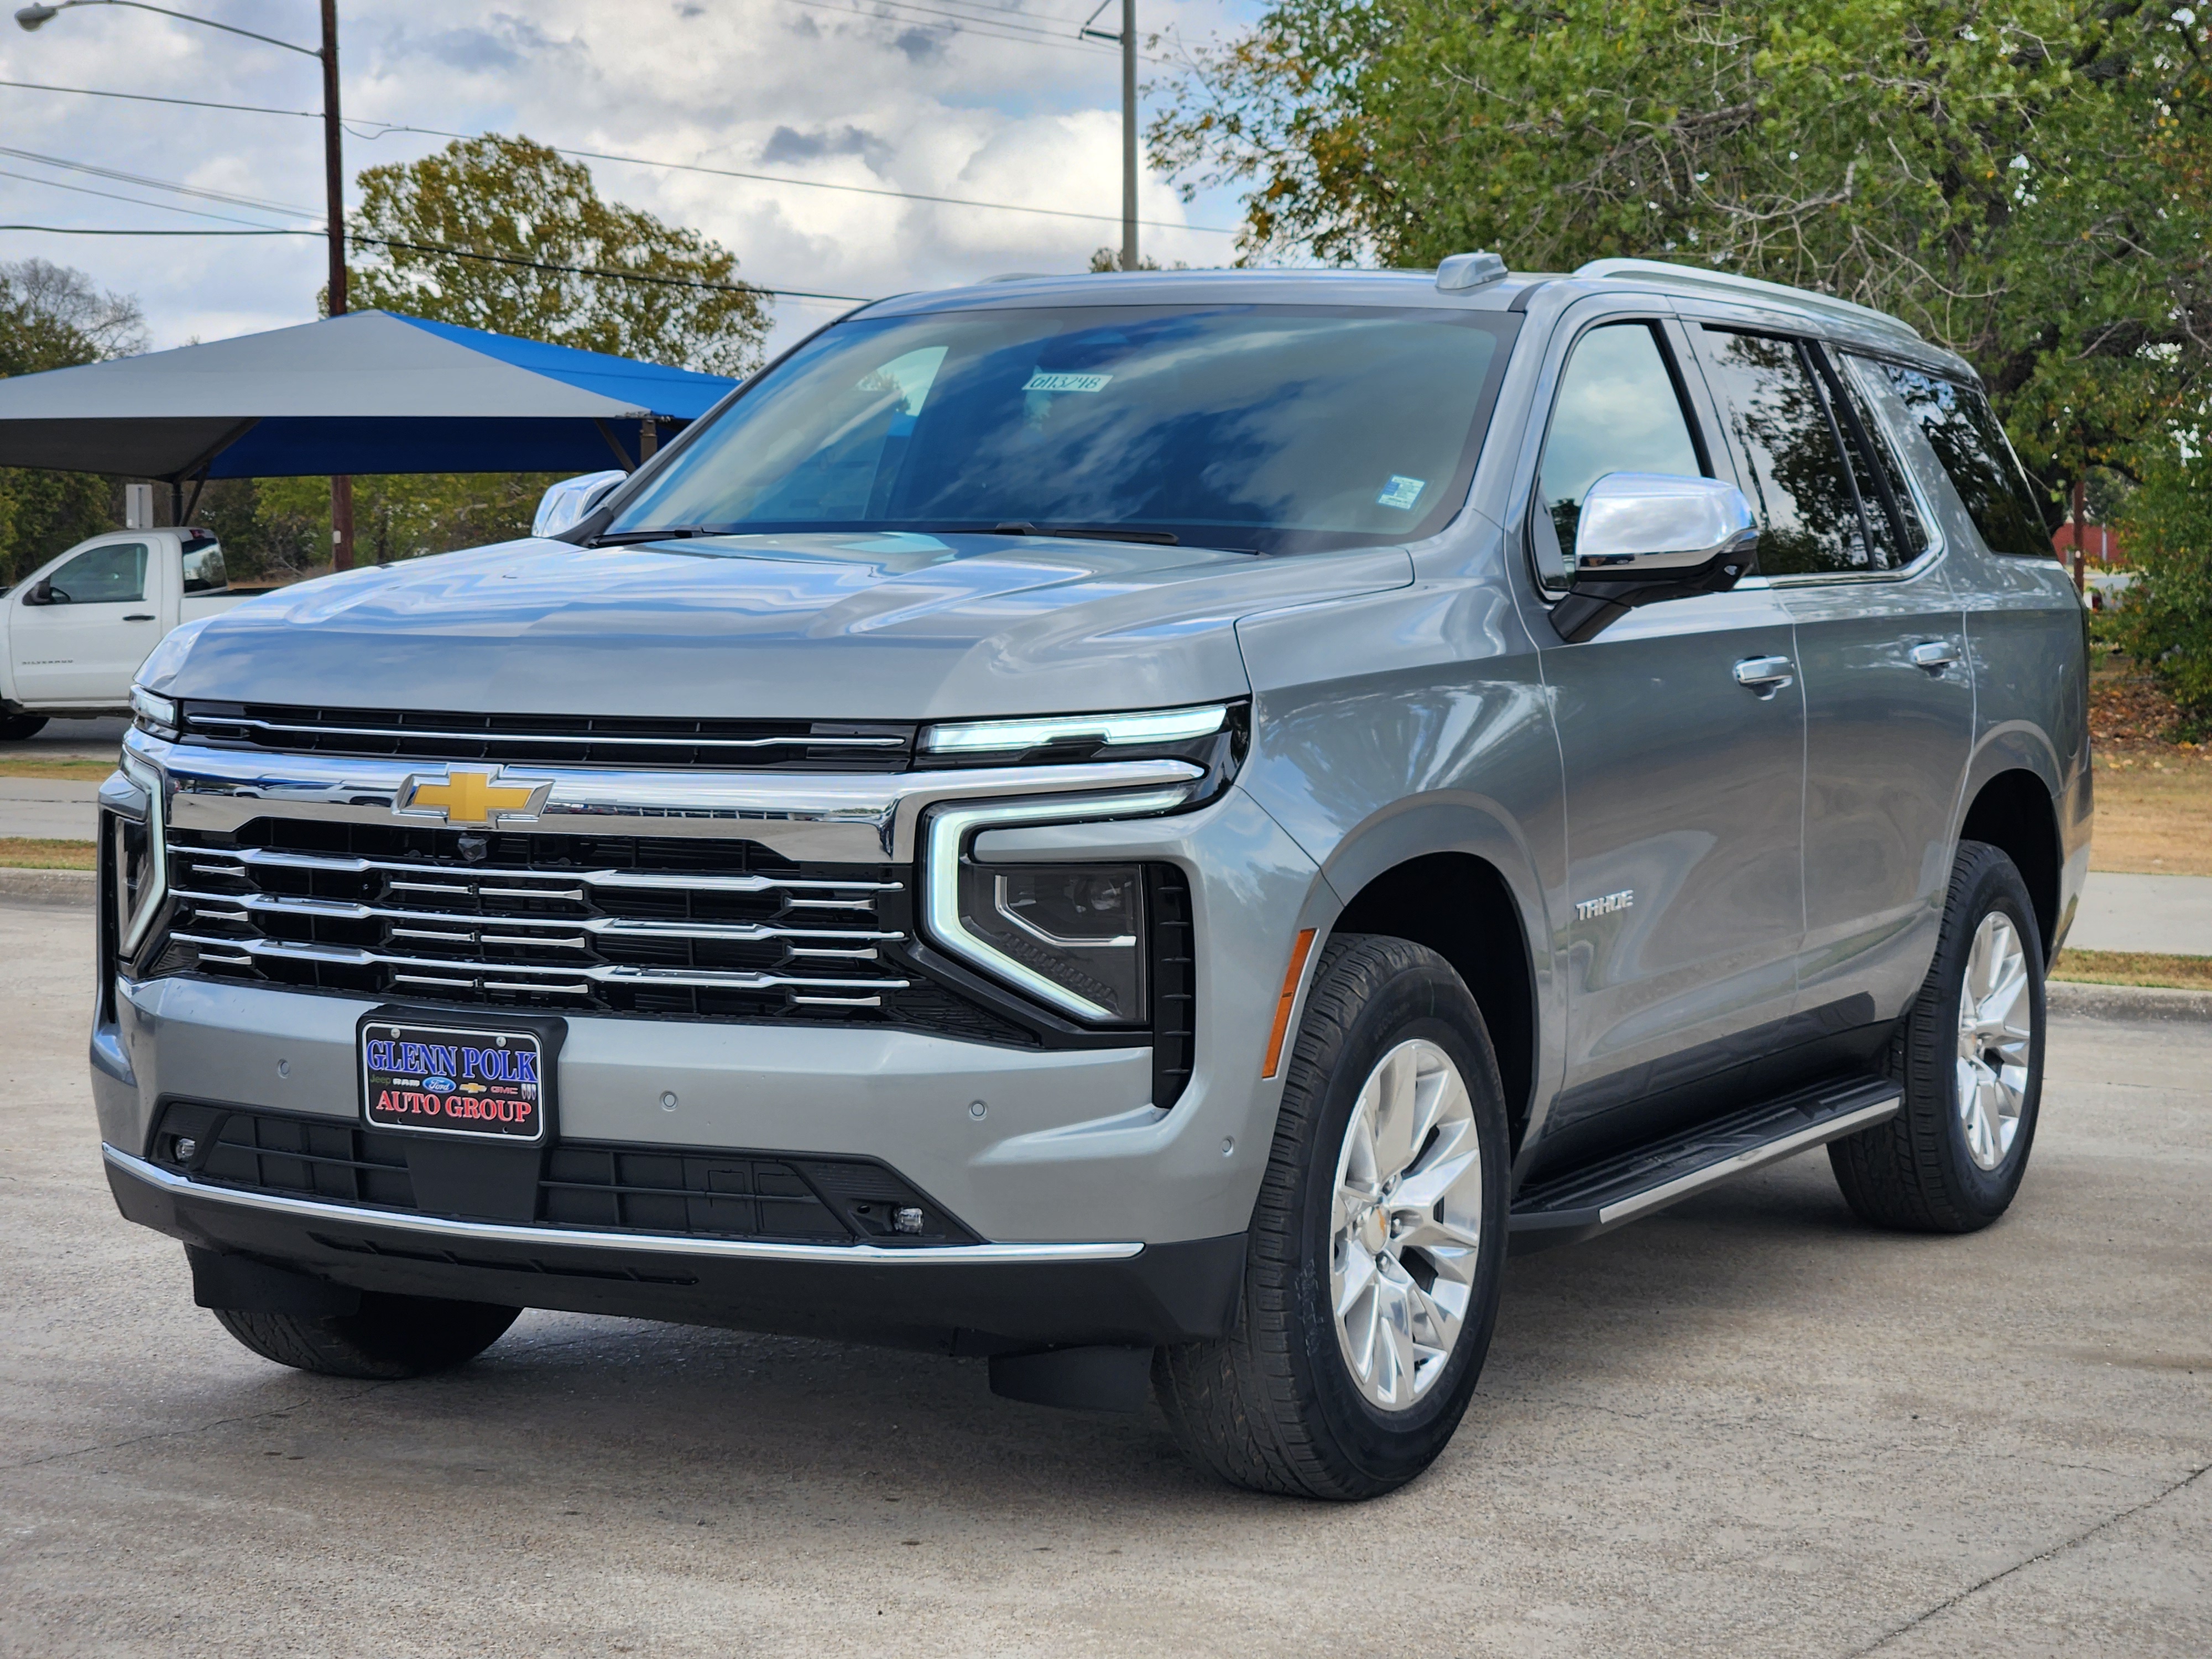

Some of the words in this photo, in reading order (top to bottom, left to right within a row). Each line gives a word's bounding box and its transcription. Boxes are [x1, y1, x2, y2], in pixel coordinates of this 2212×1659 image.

[1575, 889, 1634, 921] TAHOE
[367, 1039, 458, 1077] GLENN
[461, 1047, 538, 1083] POLK
[371, 1074, 391, 1086] Jeep
[393, 1078, 420, 1087] RAM
[429, 1080, 450, 1091] Ford
[490, 1086, 519, 1094] GMC
[375, 1089, 441, 1115] AUTO
[445, 1096, 533, 1123] GROUP
